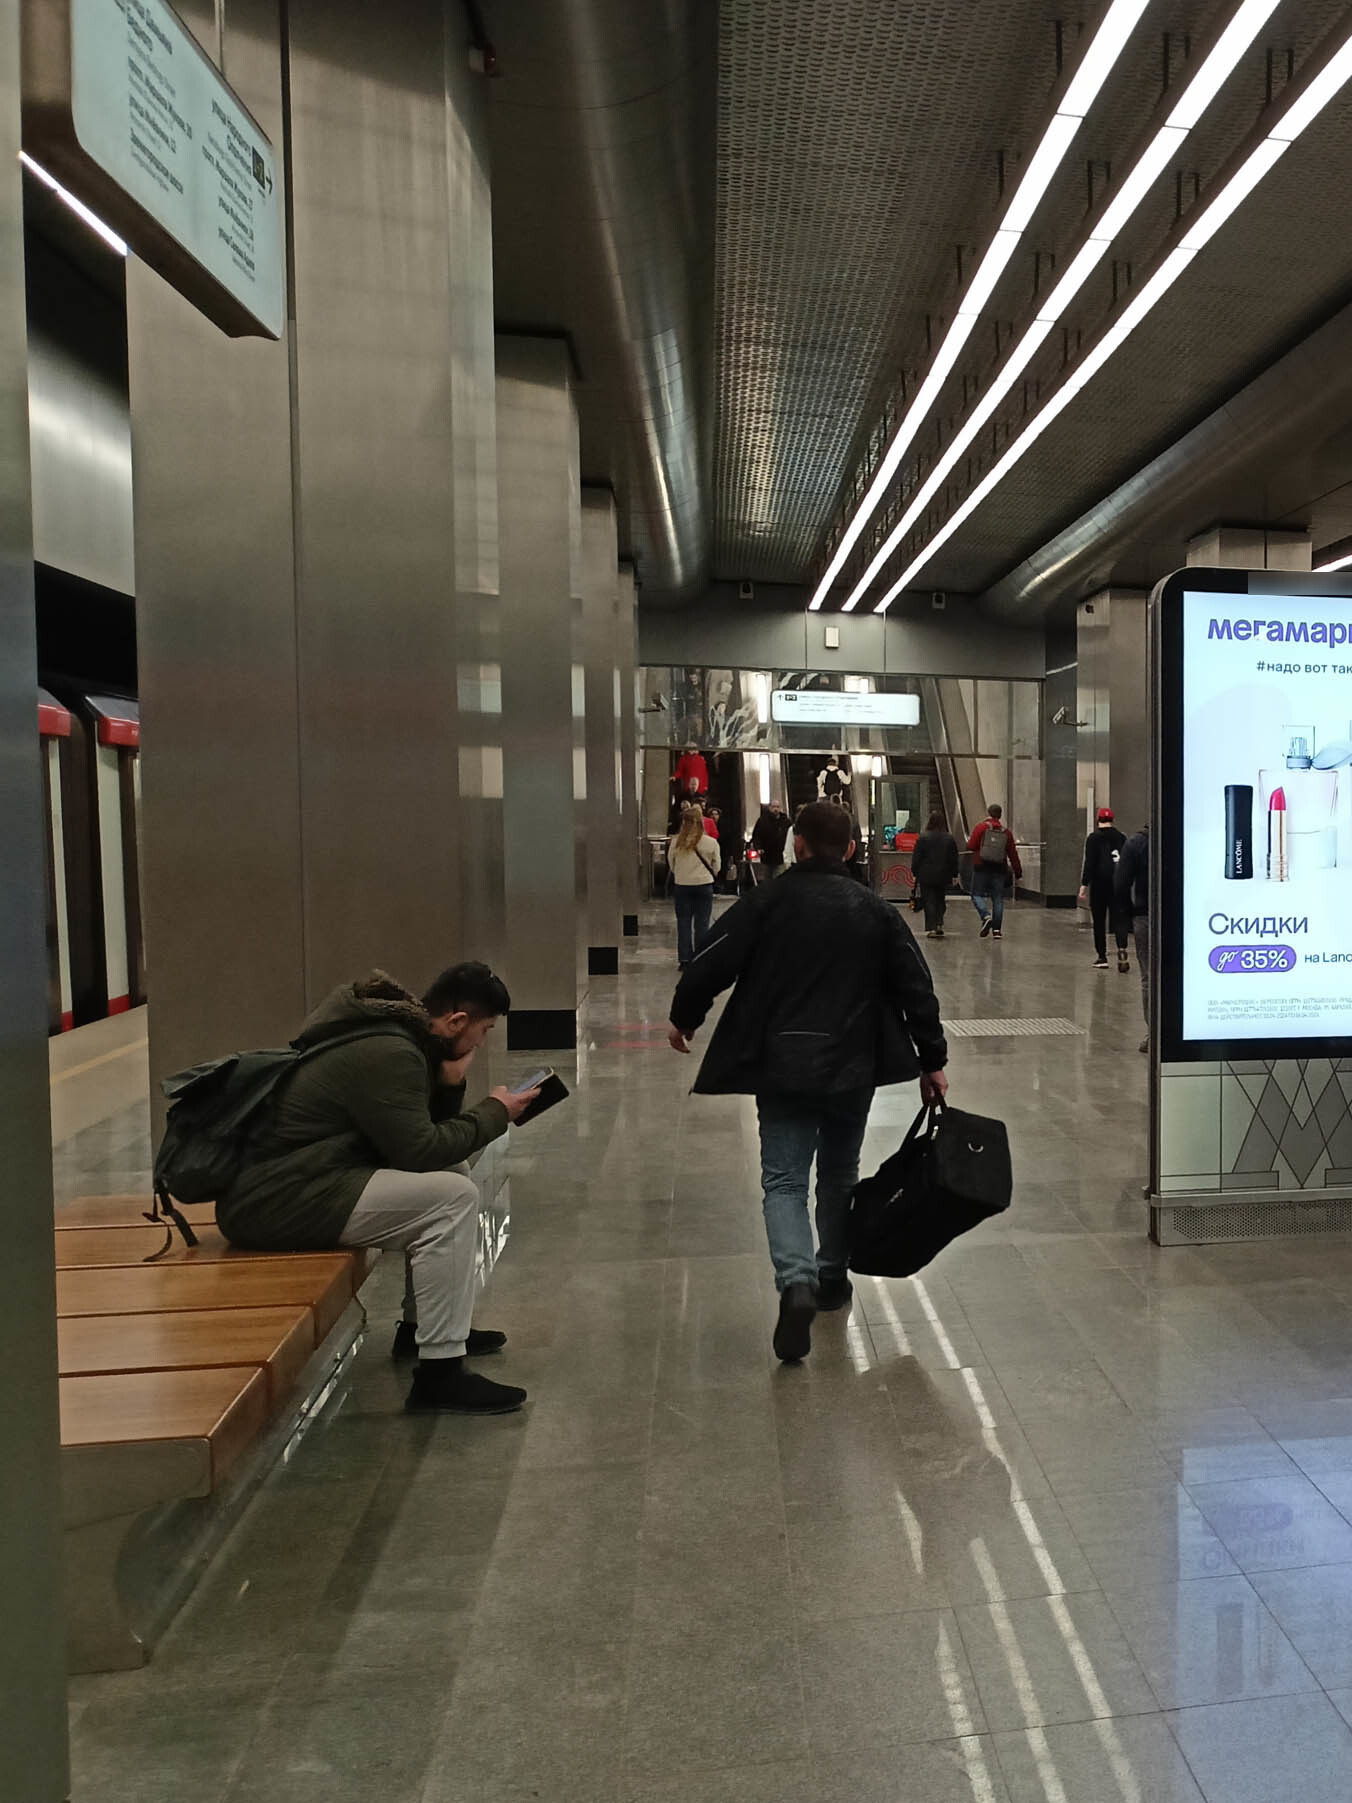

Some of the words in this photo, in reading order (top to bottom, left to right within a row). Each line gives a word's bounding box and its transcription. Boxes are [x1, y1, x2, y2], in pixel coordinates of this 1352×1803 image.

[1256, 660, 1301, 674] #надо
[1304, 663, 1328, 674] вот
[1208, 912, 1309, 938] Скидки
[1240, 949, 1289, 970] 35%
[1304, 953, 1320, 964] на
